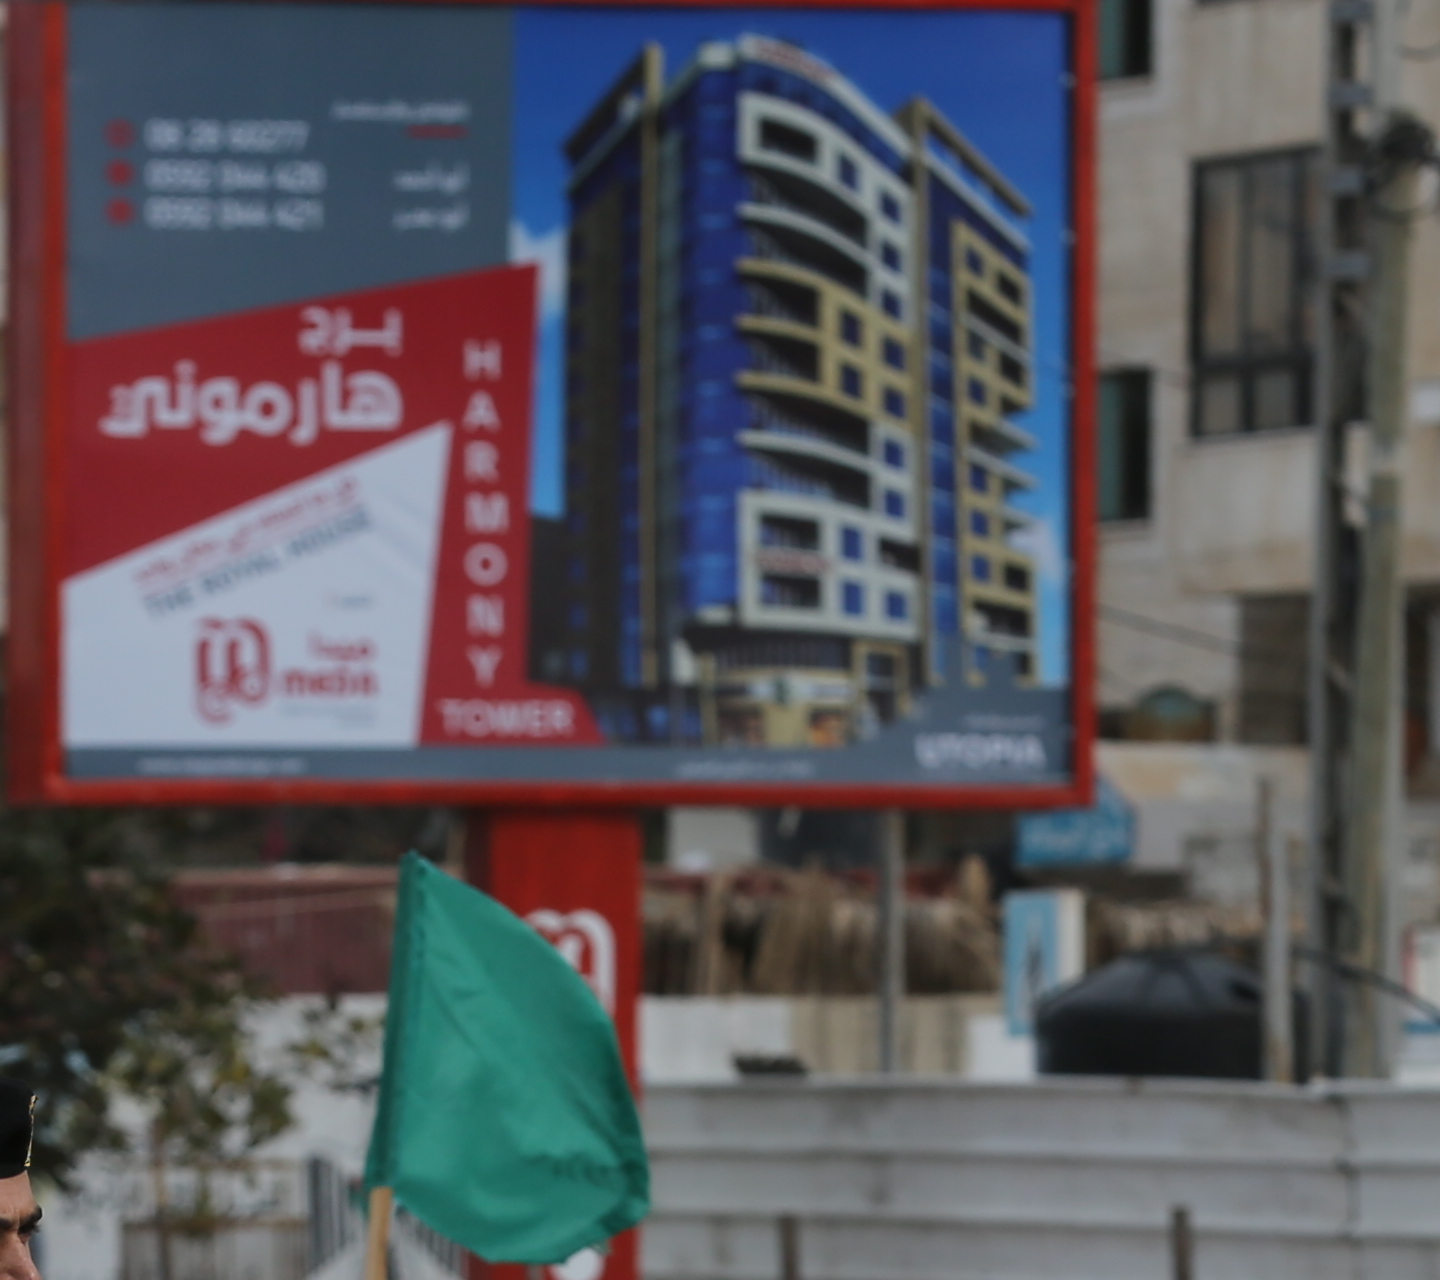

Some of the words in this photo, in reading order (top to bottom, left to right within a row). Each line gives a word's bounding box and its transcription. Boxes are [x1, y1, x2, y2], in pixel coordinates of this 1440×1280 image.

[297, 305, 404, 357] برج
[98, 360, 405, 448] هارموني
[462, 338, 511, 688] HARMONY
[145, 586, 194, 617] THE
[200, 552, 281, 593] ROYAL
[286, 507, 373, 556] HOUSE
[437, 699, 575, 737] TOWER
[914, 733, 1048, 770] UTOPIA
